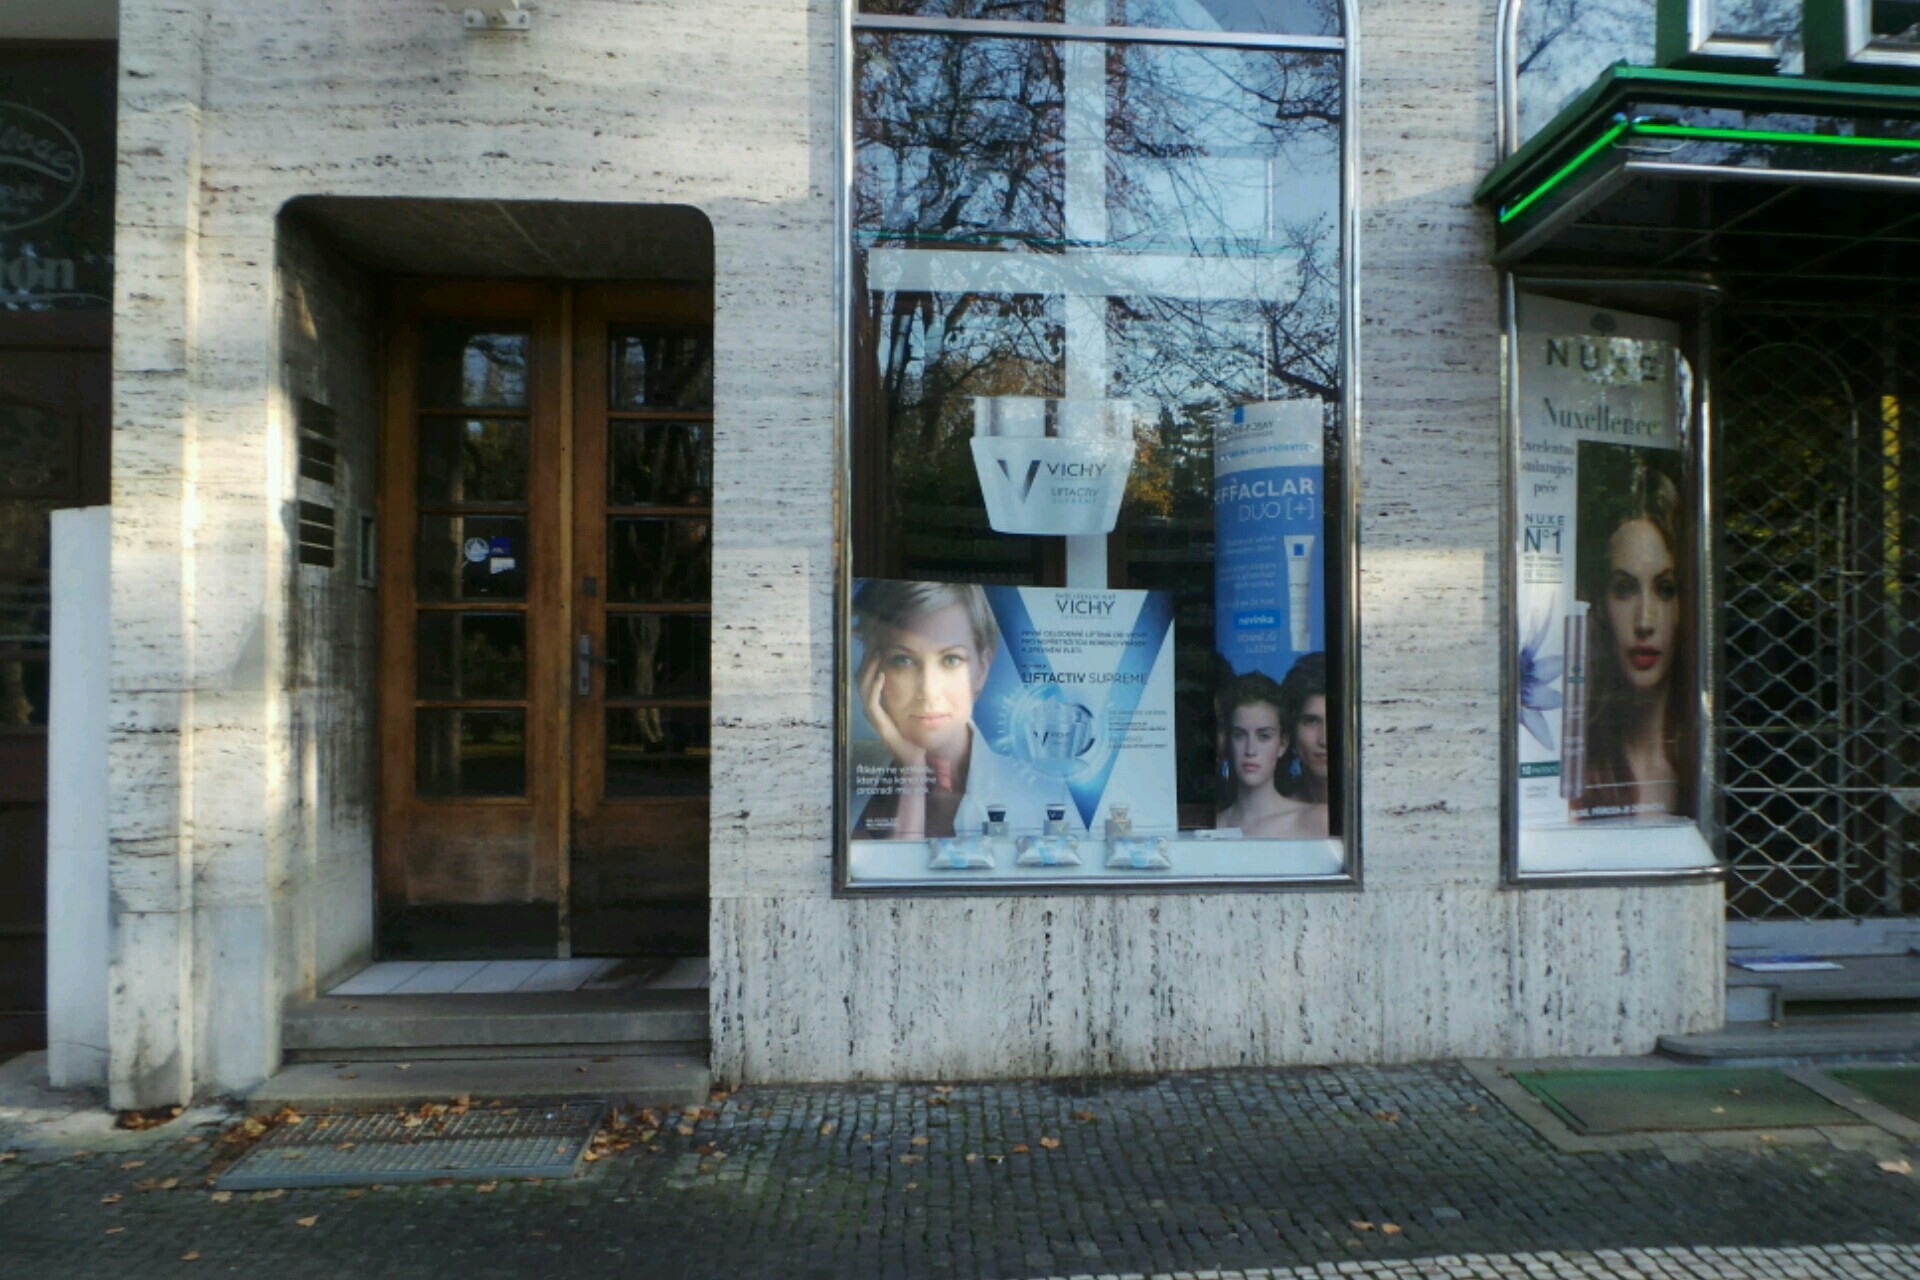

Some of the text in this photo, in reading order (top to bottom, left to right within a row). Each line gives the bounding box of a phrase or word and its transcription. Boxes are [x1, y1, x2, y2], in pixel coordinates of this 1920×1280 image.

[1546, 338, 1658, 381] NUXE
[1046, 462, 1106, 477] VICHY
[1238, 500, 1282, 523] DUO
[1524, 513, 1566, 527] NUXE
[1056, 600, 1116, 616] VICHY
[1022, 672, 1148, 684] LIFTACTIV SUPREME
